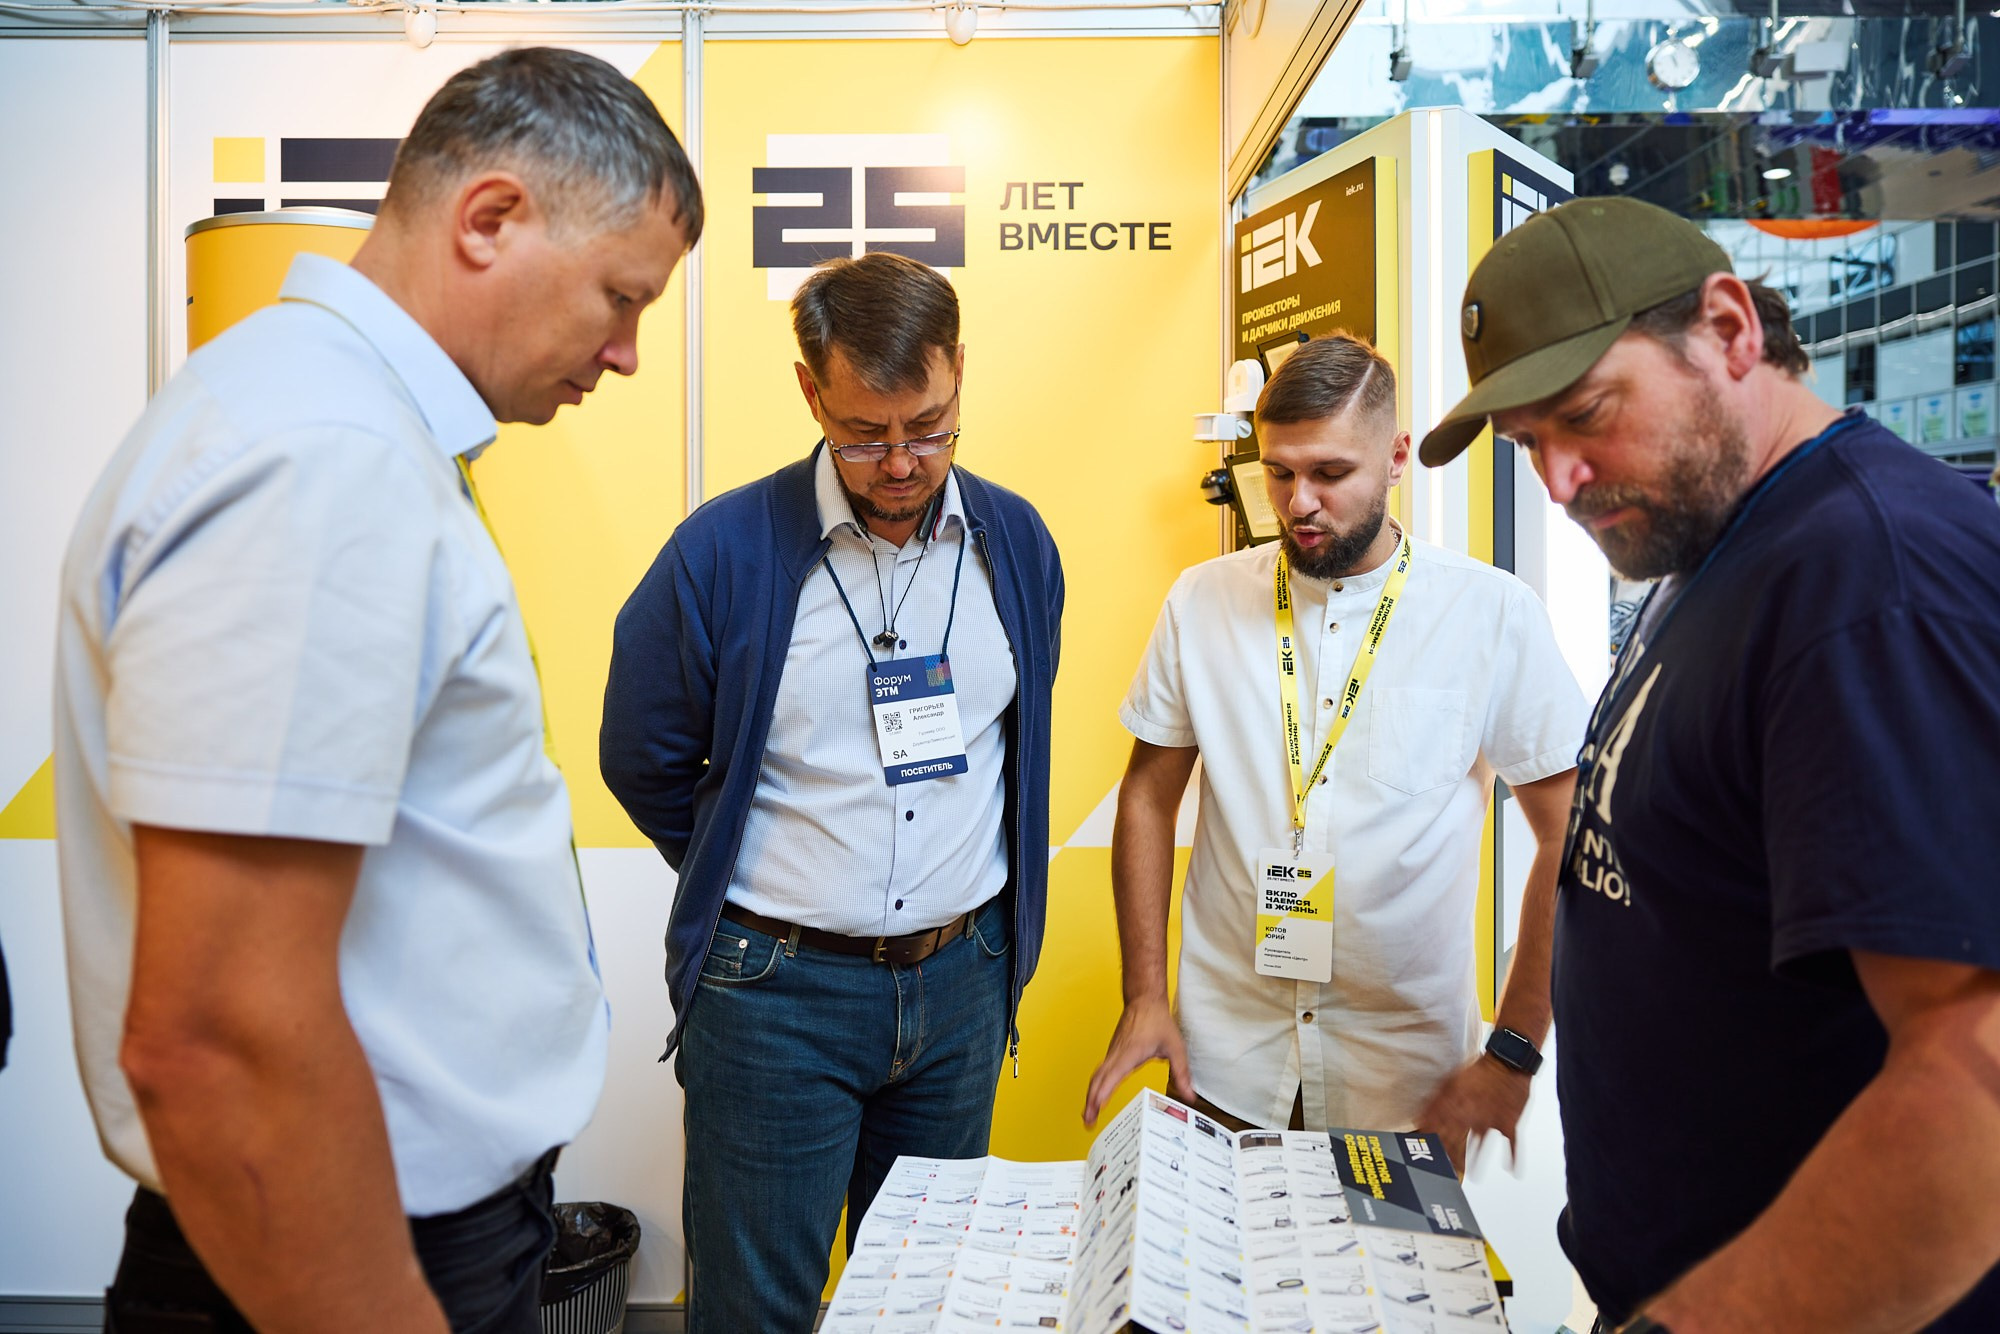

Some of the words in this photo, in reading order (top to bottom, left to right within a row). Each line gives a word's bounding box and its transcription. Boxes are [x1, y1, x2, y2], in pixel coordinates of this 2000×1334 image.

[1000, 182, 1084, 211] ЛЕТ
[1345, 182, 1364, 197] iek.ru
[753, 166, 965, 268] 25
[1000, 222, 1172, 251] ВМЕСТЕ
[1242, 294, 1301, 325] ПРОЖЕКТОРЫ
[1242, 331, 1249, 343] И
[1249, 318, 1288, 343] ДАТЧИКИ
[1288, 299, 1341, 330] ДВИЖЕНИЯ
[1397, 560, 1407, 574] 25
[1368, 598, 1394, 655] ВКЛЮЧАЕМСЯ
[1369, 604, 1386, 635] ЖИЗНЬ!
[1282, 636, 1290, 648] 25
[873, 674, 912, 687] Форум
[876, 686, 899, 698] ЭТМ
[908, 702, 945, 714] ГРИГОРЬЕВ
[912, 711, 945, 721] Александр
[1286, 702, 1295, 765] ВКЛЮЧАЕМСЯ
[892, 749, 908, 760] SA
[901, 762, 954, 777] ПОСЕТИТЕЛЬ
[1296, 869, 1312, 878] 25
[1265, 889, 1298, 898] ВКЛЮ
[1265, 896, 1311, 907] ЧАЕМСЯ
[1275, 904, 1318, 914] ЖИЗНЬ!
[1265, 926, 1287, 934] КОТОВ
[1265, 933, 1286, 941] ЮРИЙ
[1344, 1133, 1367, 1184] ОСВЕЩЕНИЕ
[1368, 1135, 1392, 1184] ПРОЕКТНОЕ
[1356, 1134, 1386, 1200] СВЕТОДИОДНОЕ
